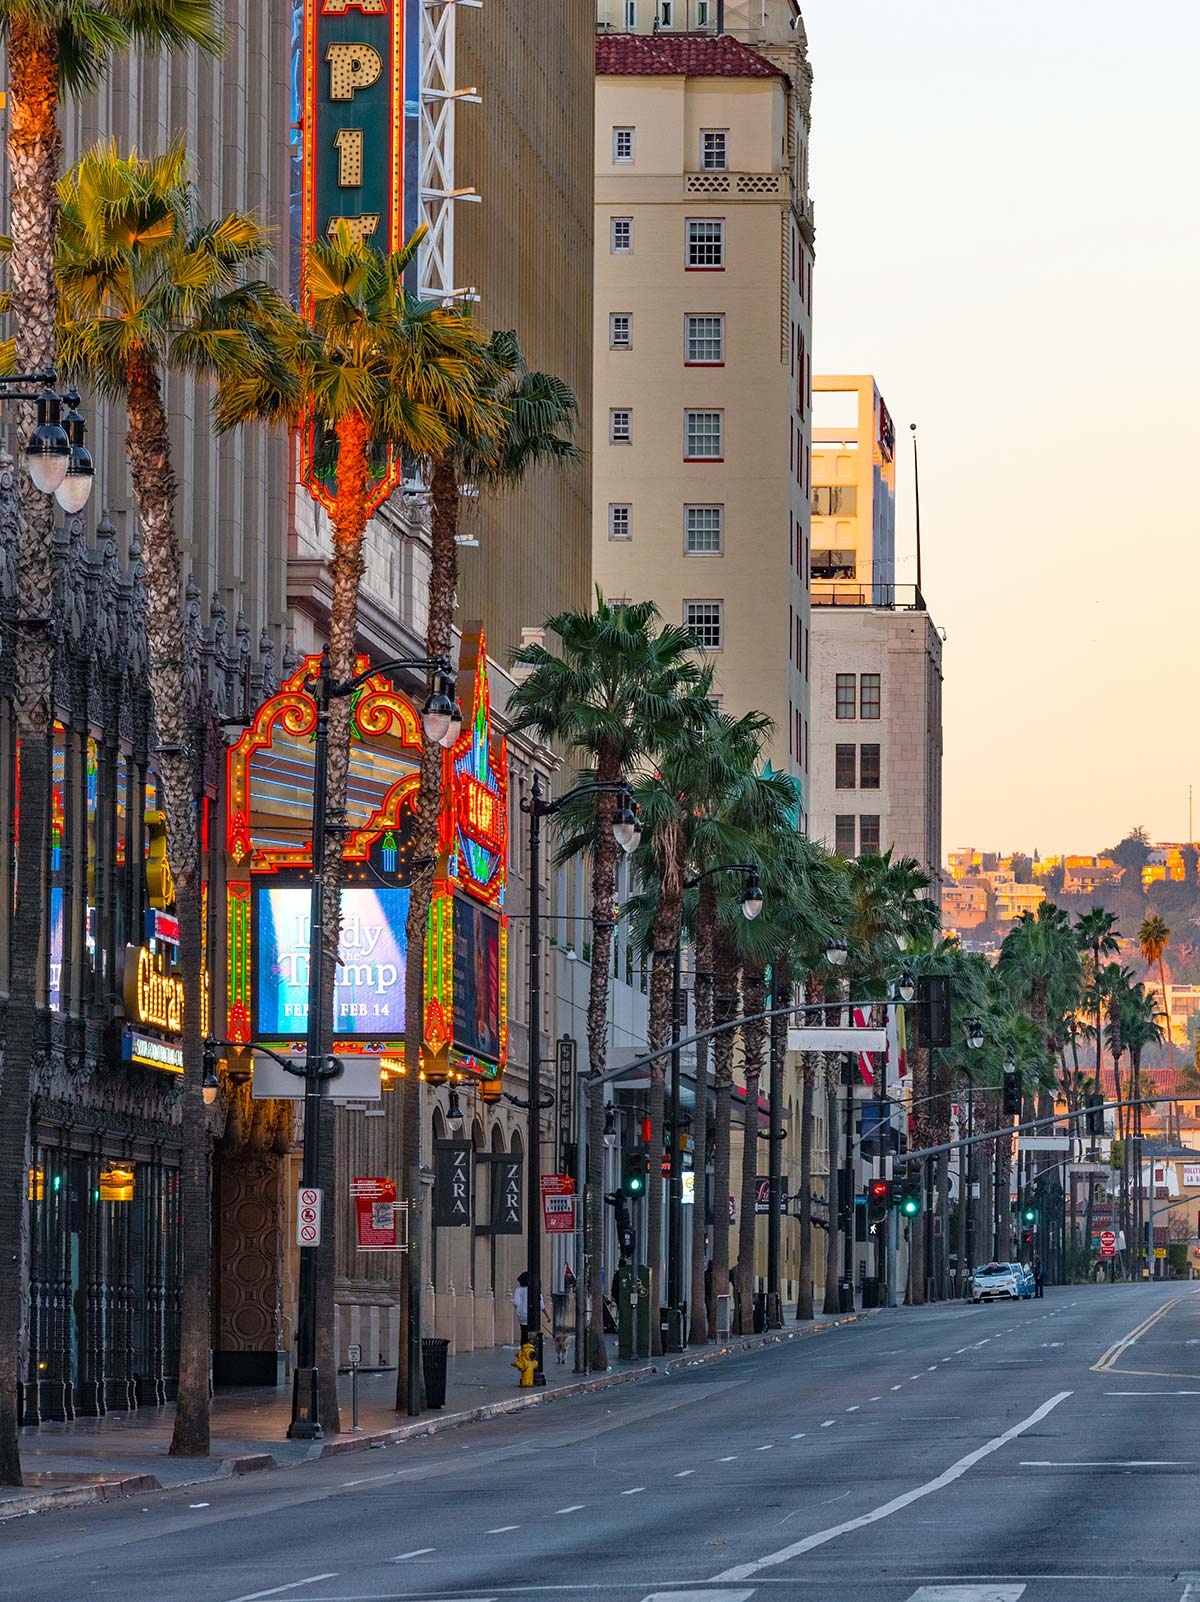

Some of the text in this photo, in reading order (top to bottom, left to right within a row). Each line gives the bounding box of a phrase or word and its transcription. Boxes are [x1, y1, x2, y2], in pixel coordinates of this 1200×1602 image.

[295, 914, 383, 956] Ldy
[277, 952, 398, 995] Tmp
[340, 1003, 368, 1016] FEB
[374, 1003, 390, 1016] 14
[451, 1151, 467, 1214] ZARA
[505, 1164, 520, 1223] ZARA
